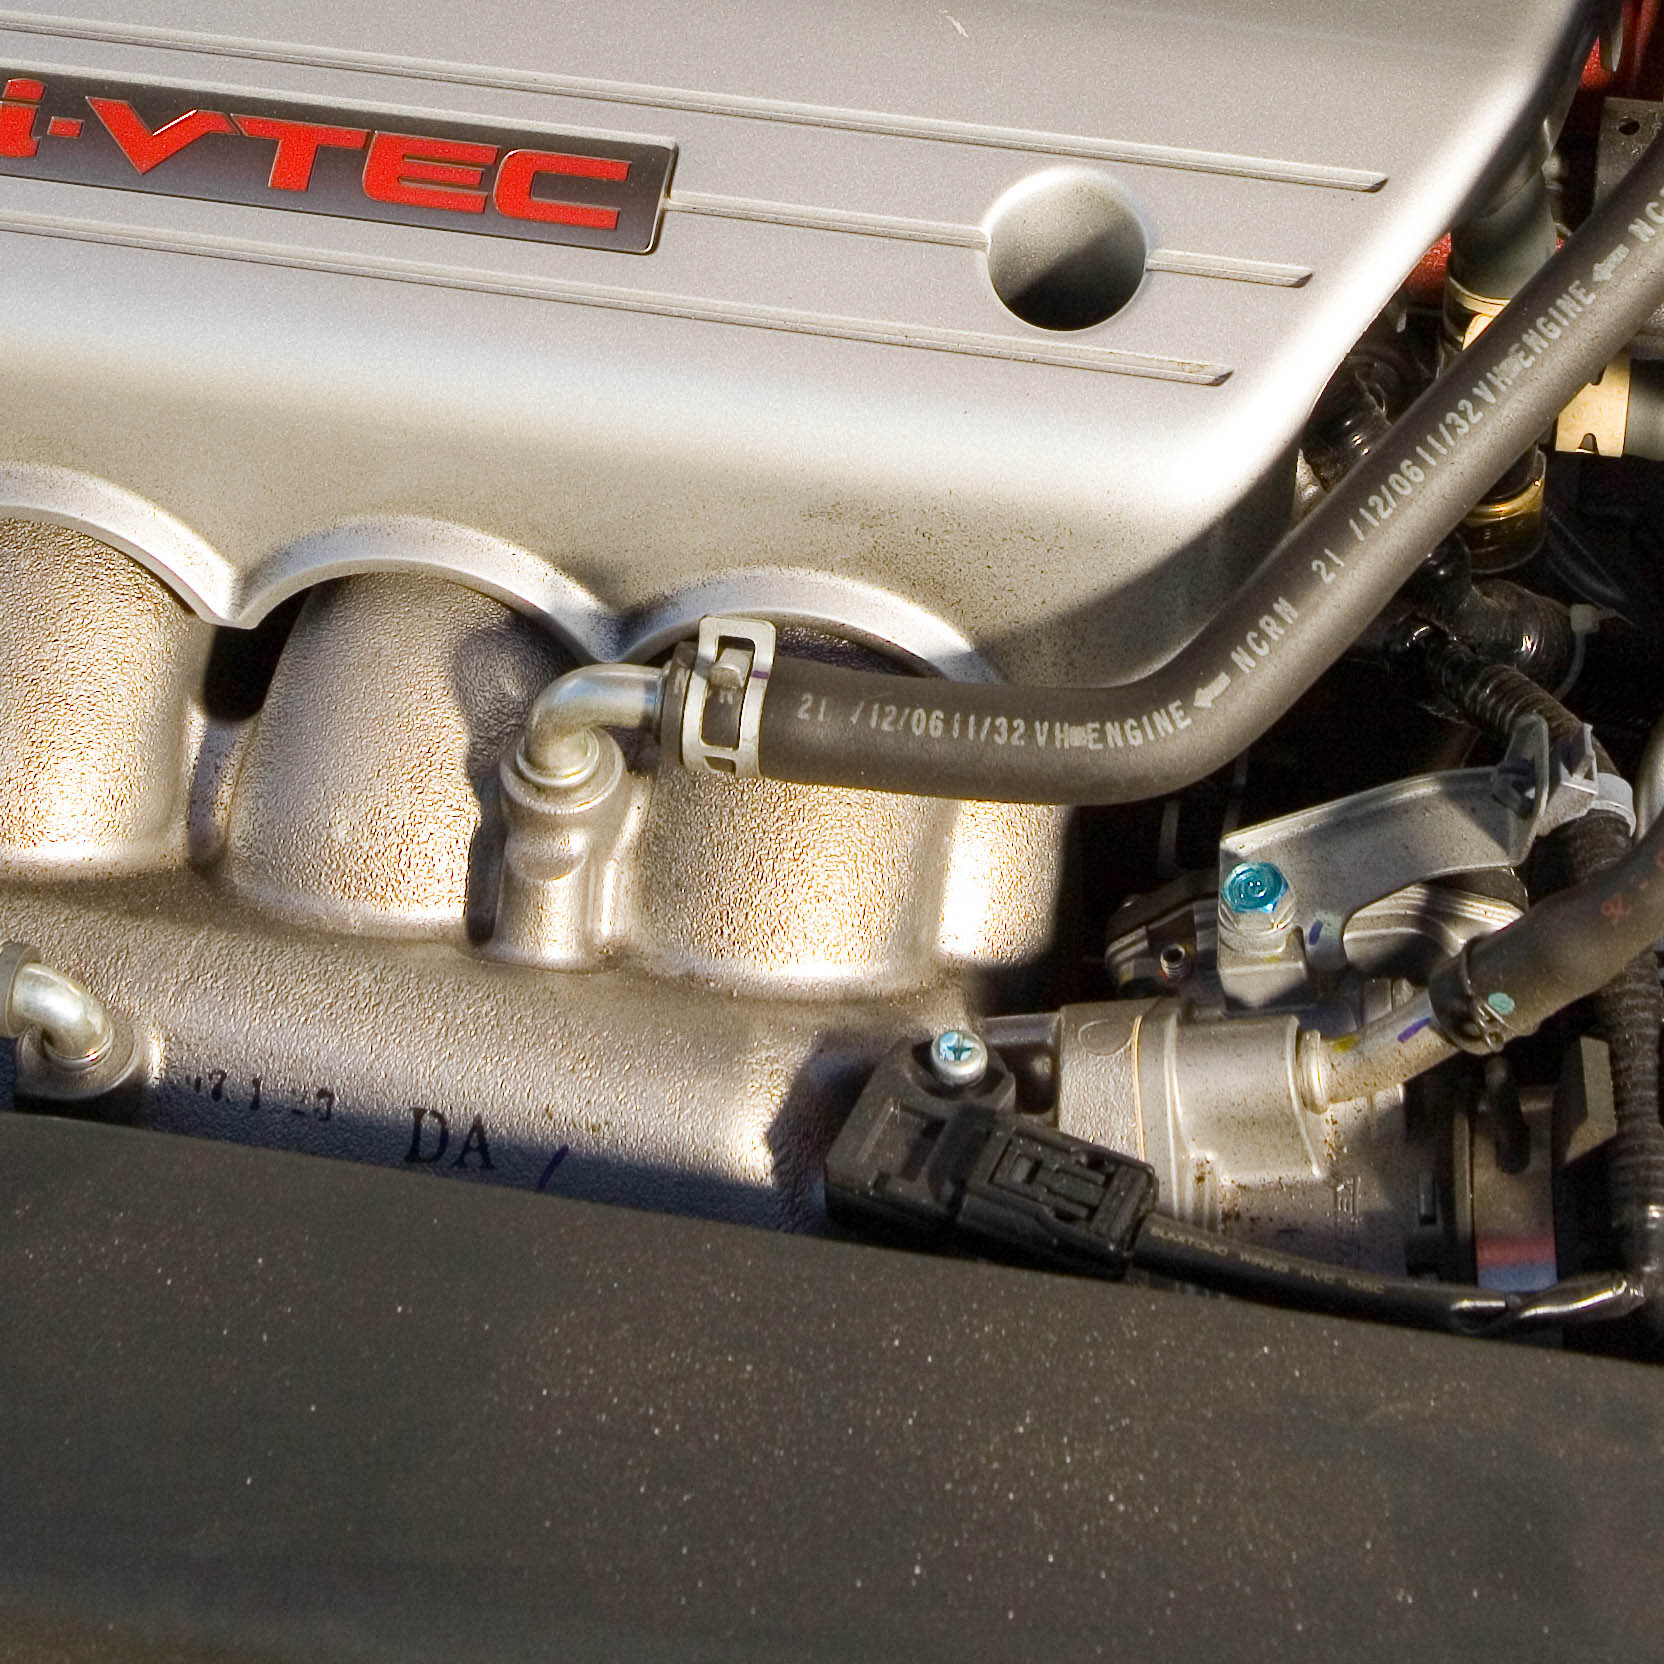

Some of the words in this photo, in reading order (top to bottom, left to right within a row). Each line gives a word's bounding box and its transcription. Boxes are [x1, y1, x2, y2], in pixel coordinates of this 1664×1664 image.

[1085, 698, 1193, 751] ENGINE
[1230, 595, 1299, 674] NCRN
[403, 1106, 498, 1170] DA
